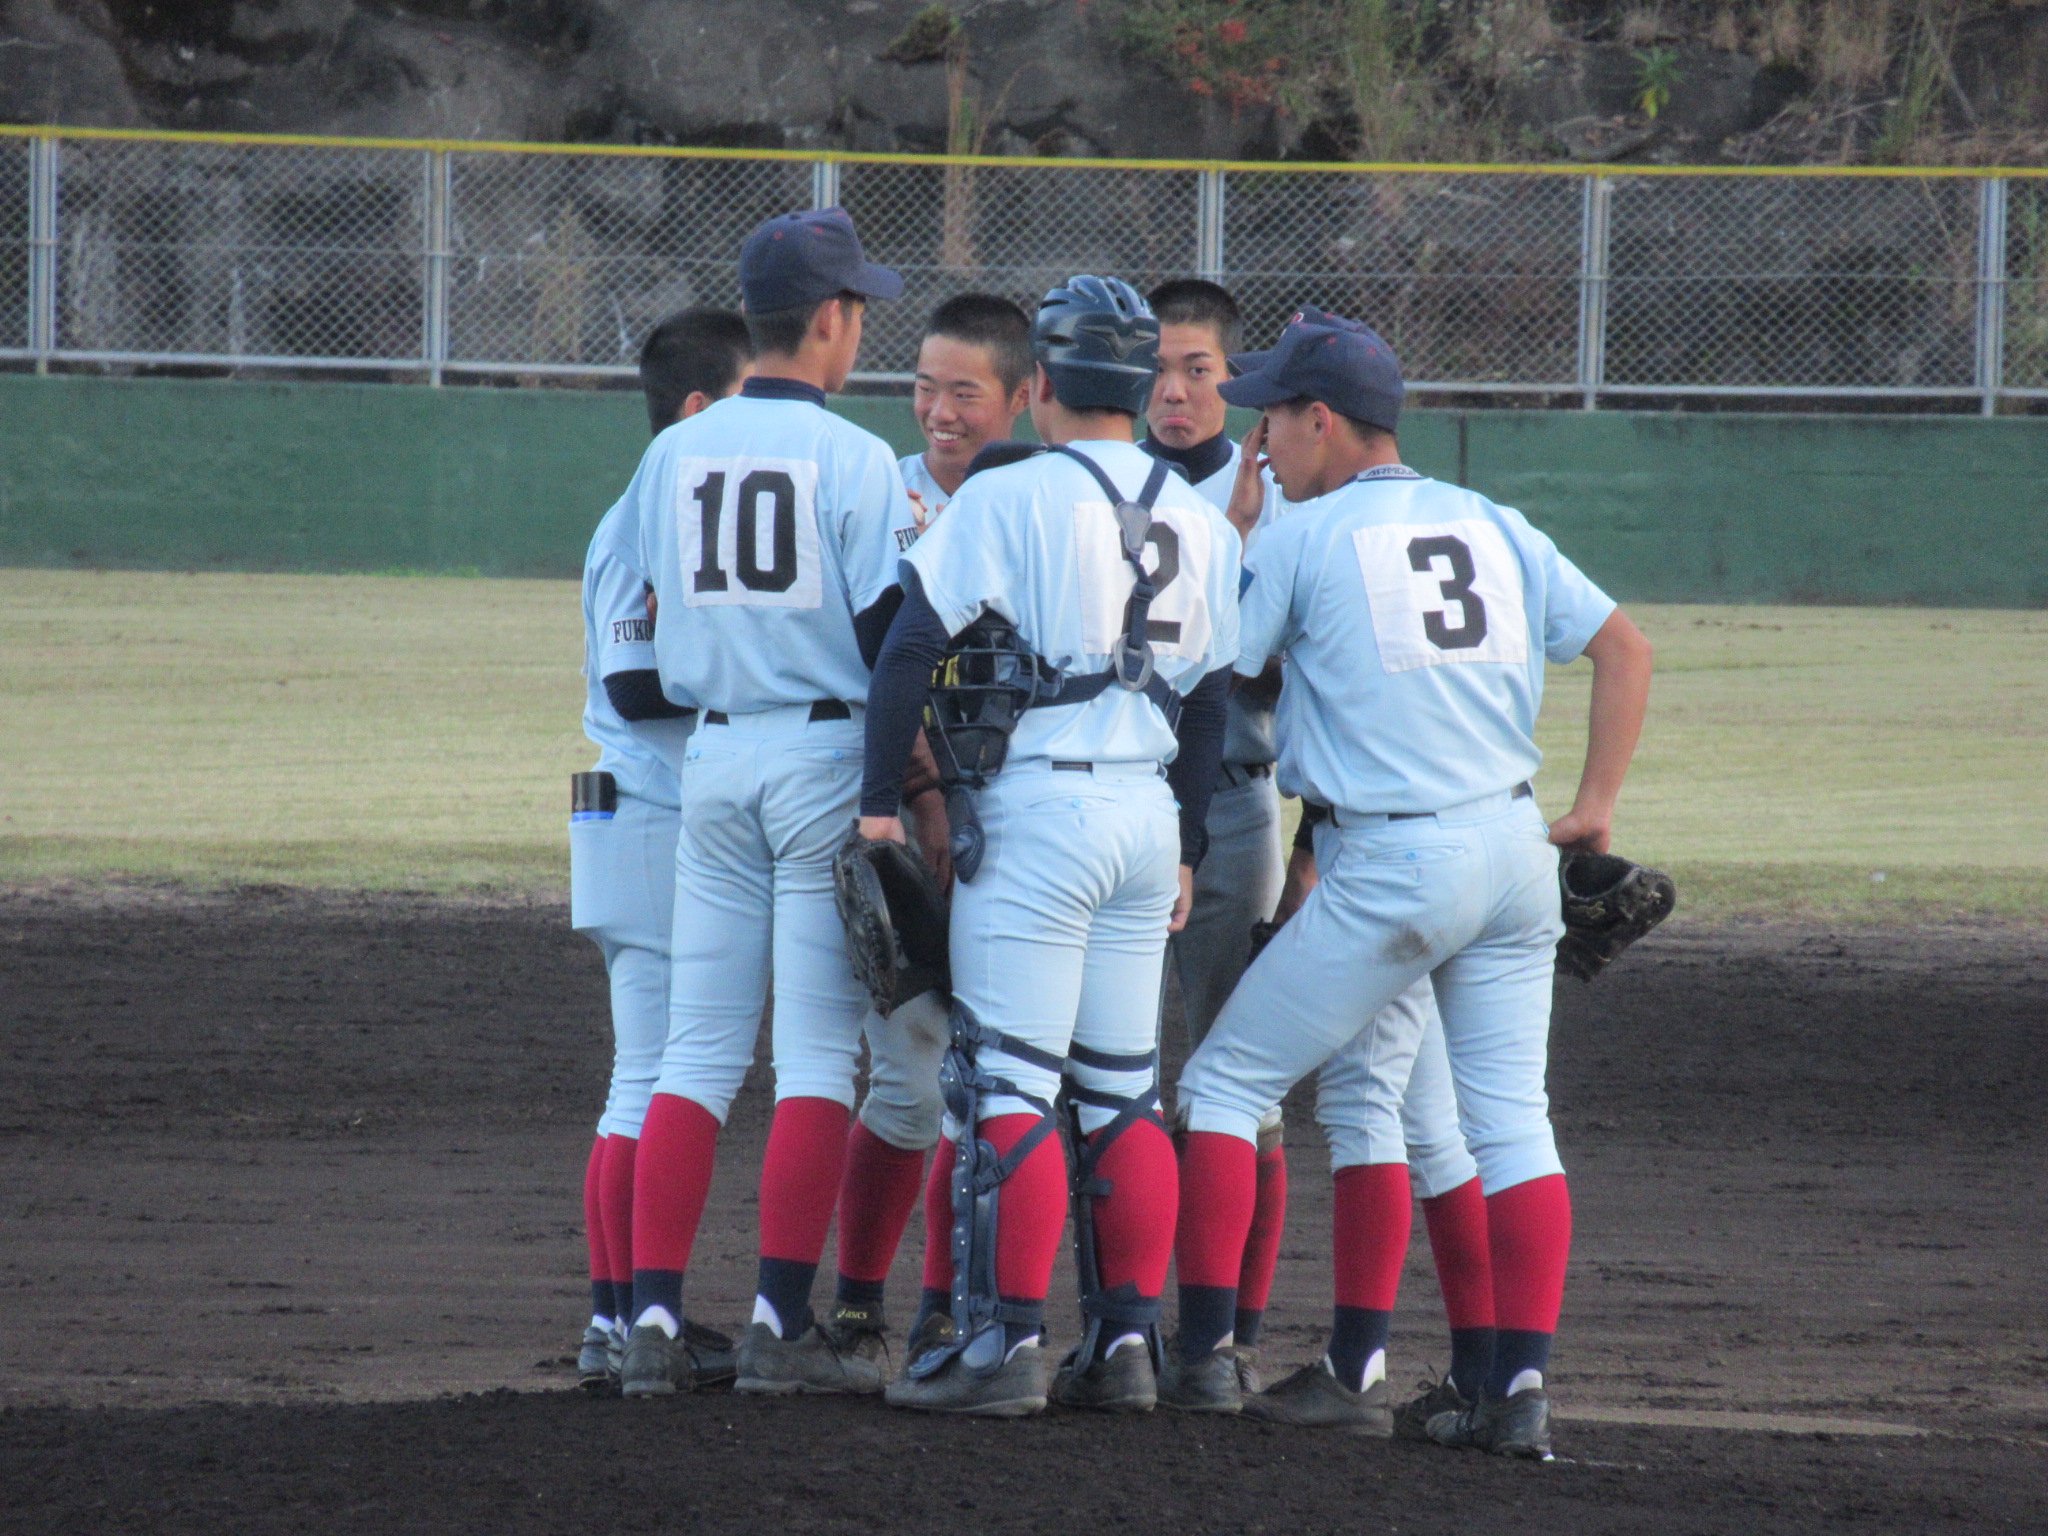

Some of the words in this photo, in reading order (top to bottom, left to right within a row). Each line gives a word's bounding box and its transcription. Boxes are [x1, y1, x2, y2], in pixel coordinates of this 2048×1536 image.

[693, 470, 797, 593] 10
[1119, 521, 1181, 644] 2
[1407, 535, 1487, 650] 3
